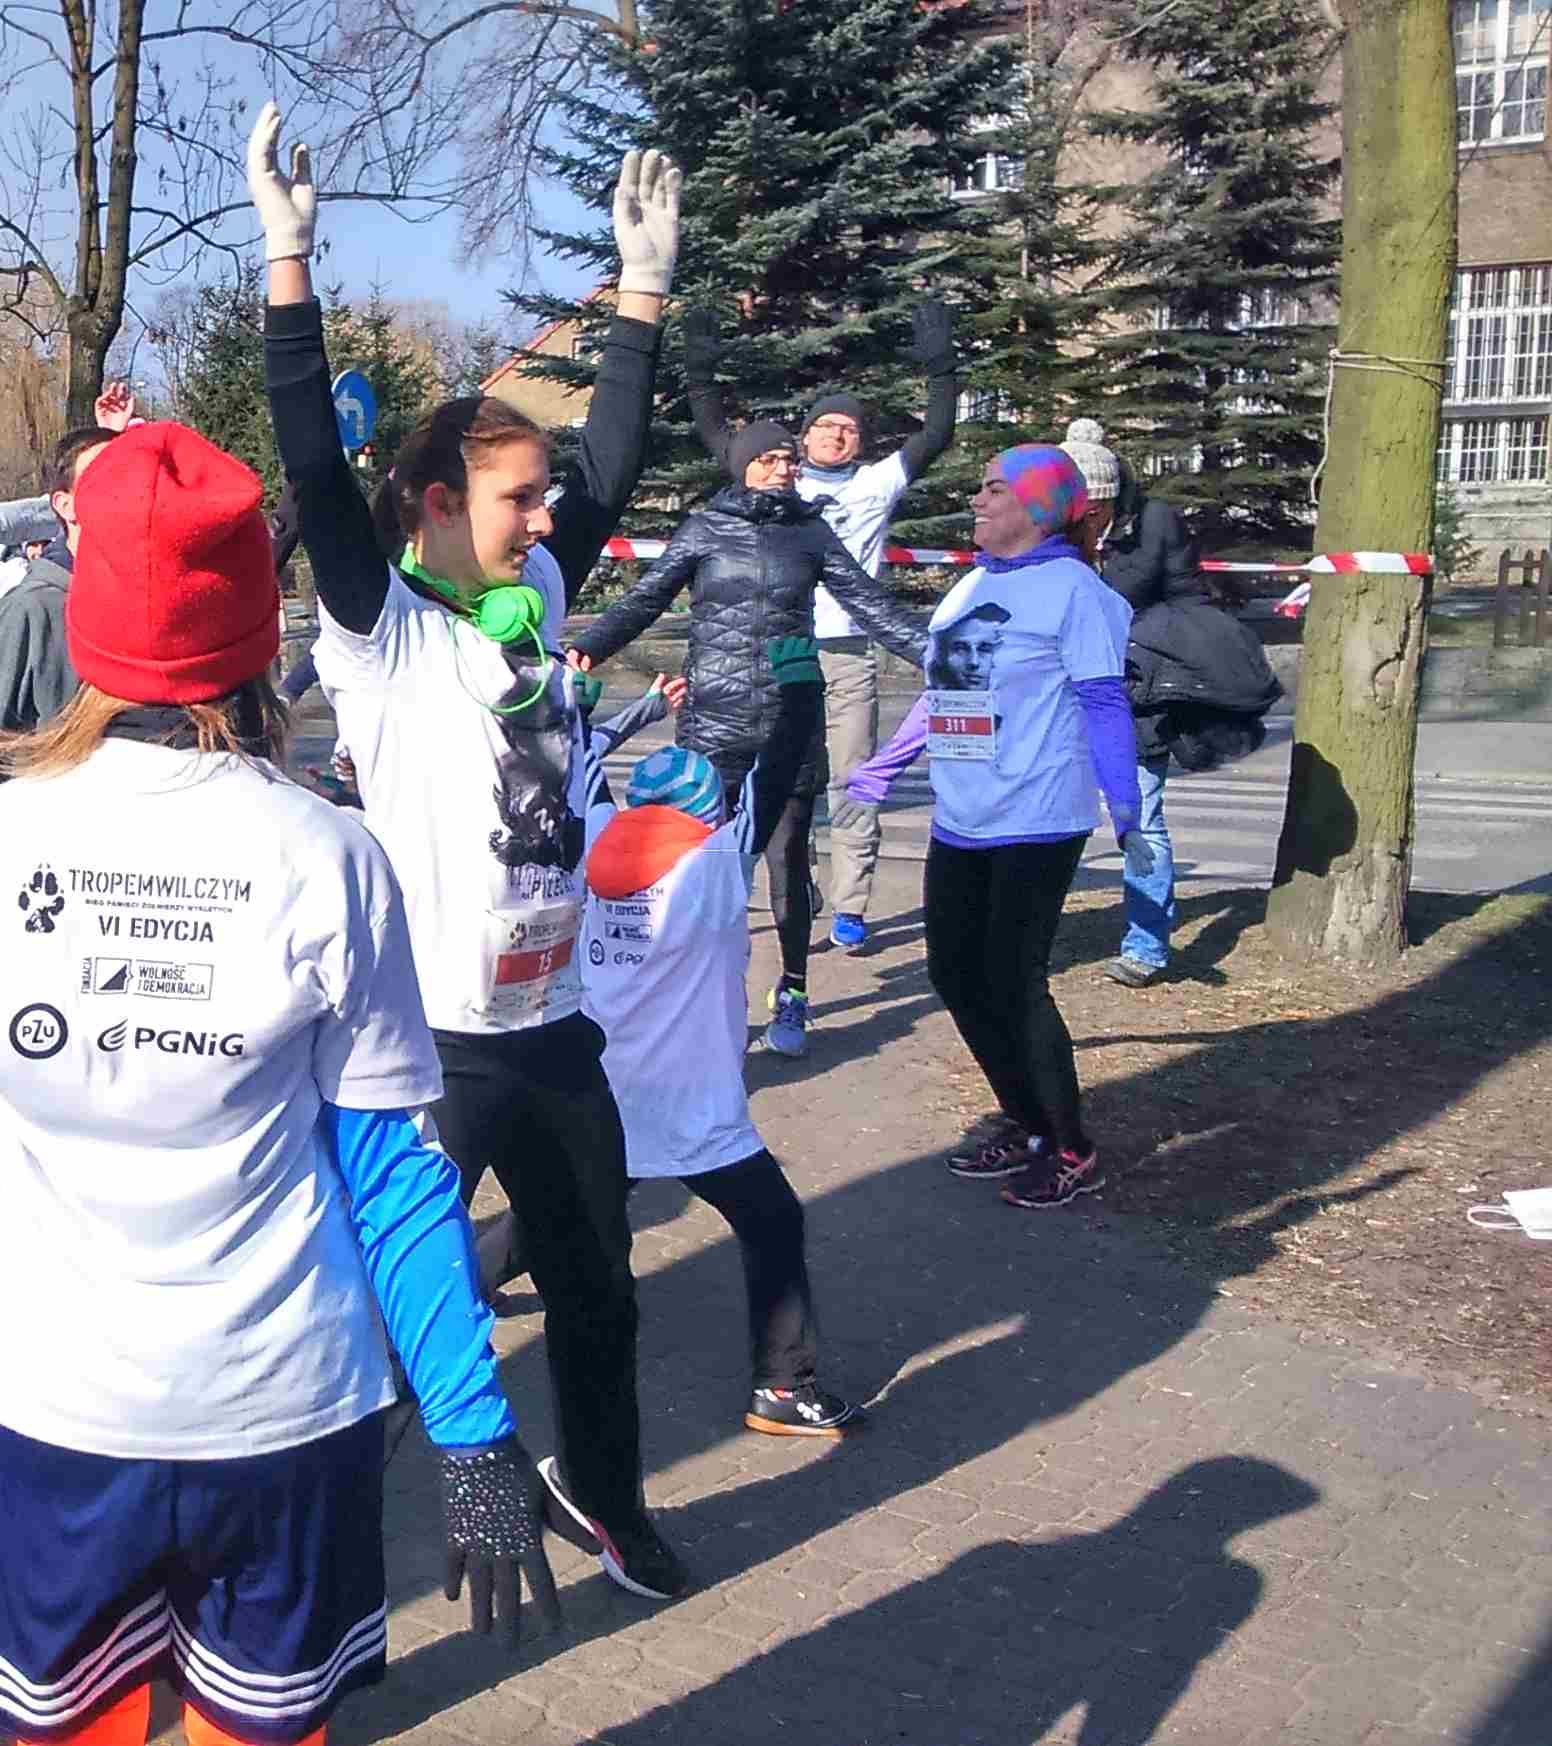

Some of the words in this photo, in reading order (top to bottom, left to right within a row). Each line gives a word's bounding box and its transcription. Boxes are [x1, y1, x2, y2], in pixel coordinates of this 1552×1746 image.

[944, 718, 967, 732] 311
[68, 869, 252, 903] TROPEMWILCZYM
[98, 915, 120, 936] VI
[130, 917, 214, 943] EDYCJA
[22, 1020, 55, 1044] PZU
[134, 1027, 245, 1057] PGNiG
